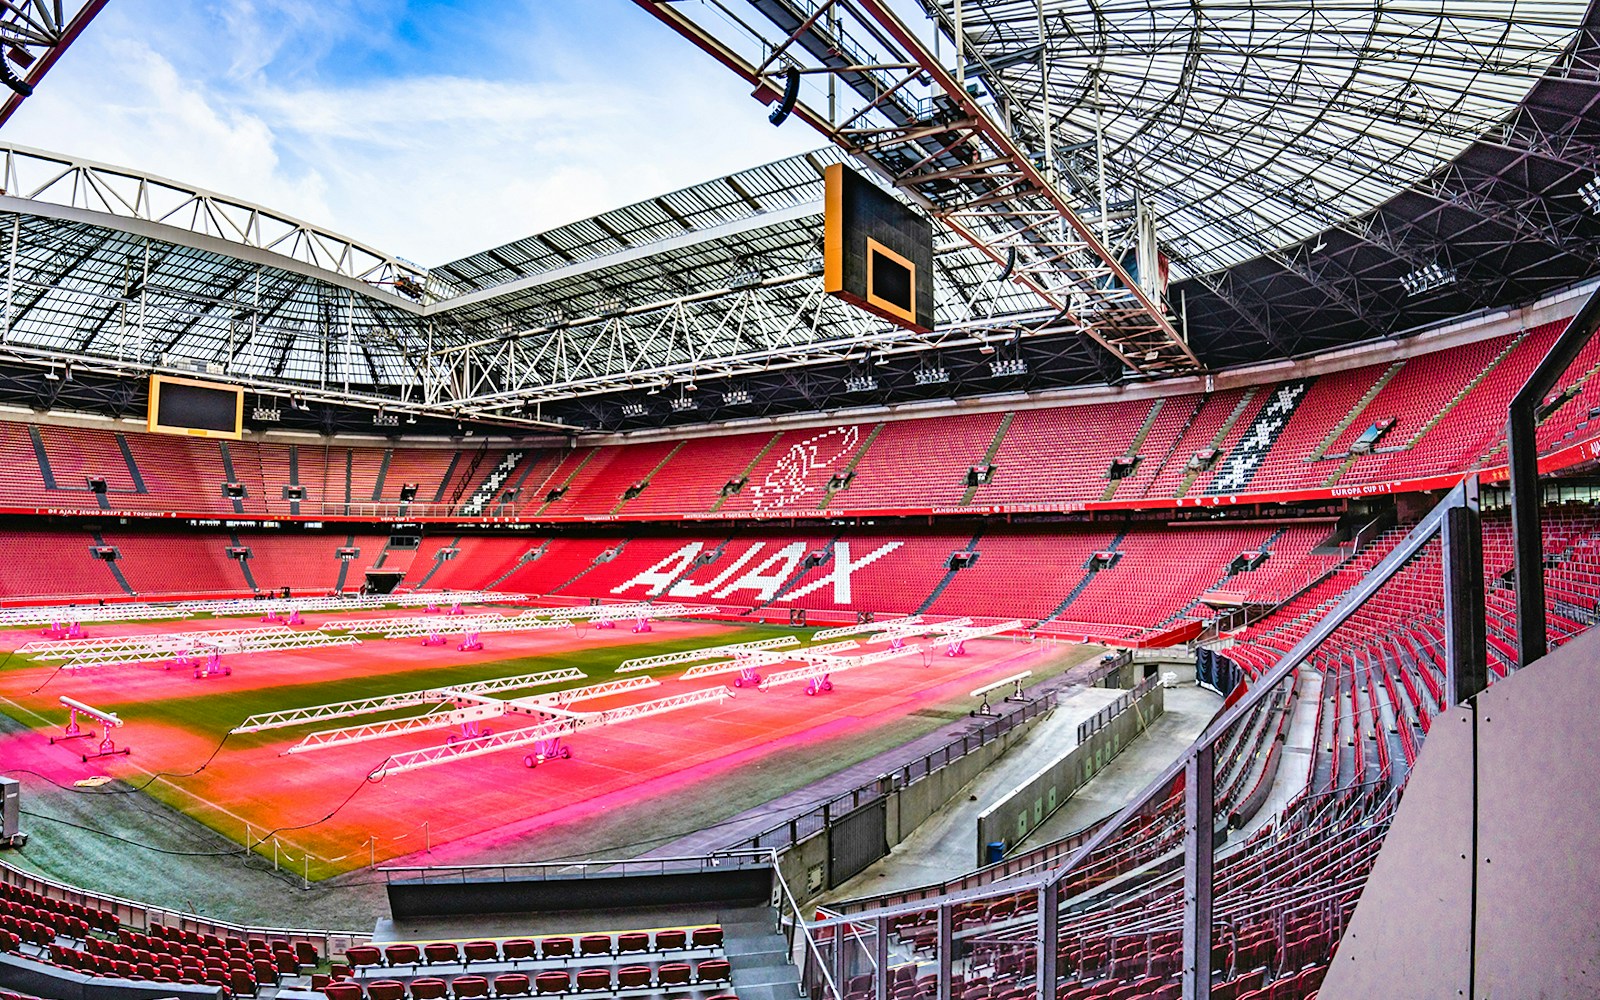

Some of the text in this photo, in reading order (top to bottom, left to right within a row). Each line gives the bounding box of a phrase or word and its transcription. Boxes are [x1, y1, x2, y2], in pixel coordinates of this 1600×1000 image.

[1331, 485, 1362, 497] EUROPA
[1363, 485, 1377, 494] CUP
[59, 508, 78, 516] AJAX
[610, 541, 904, 604] AJAX
